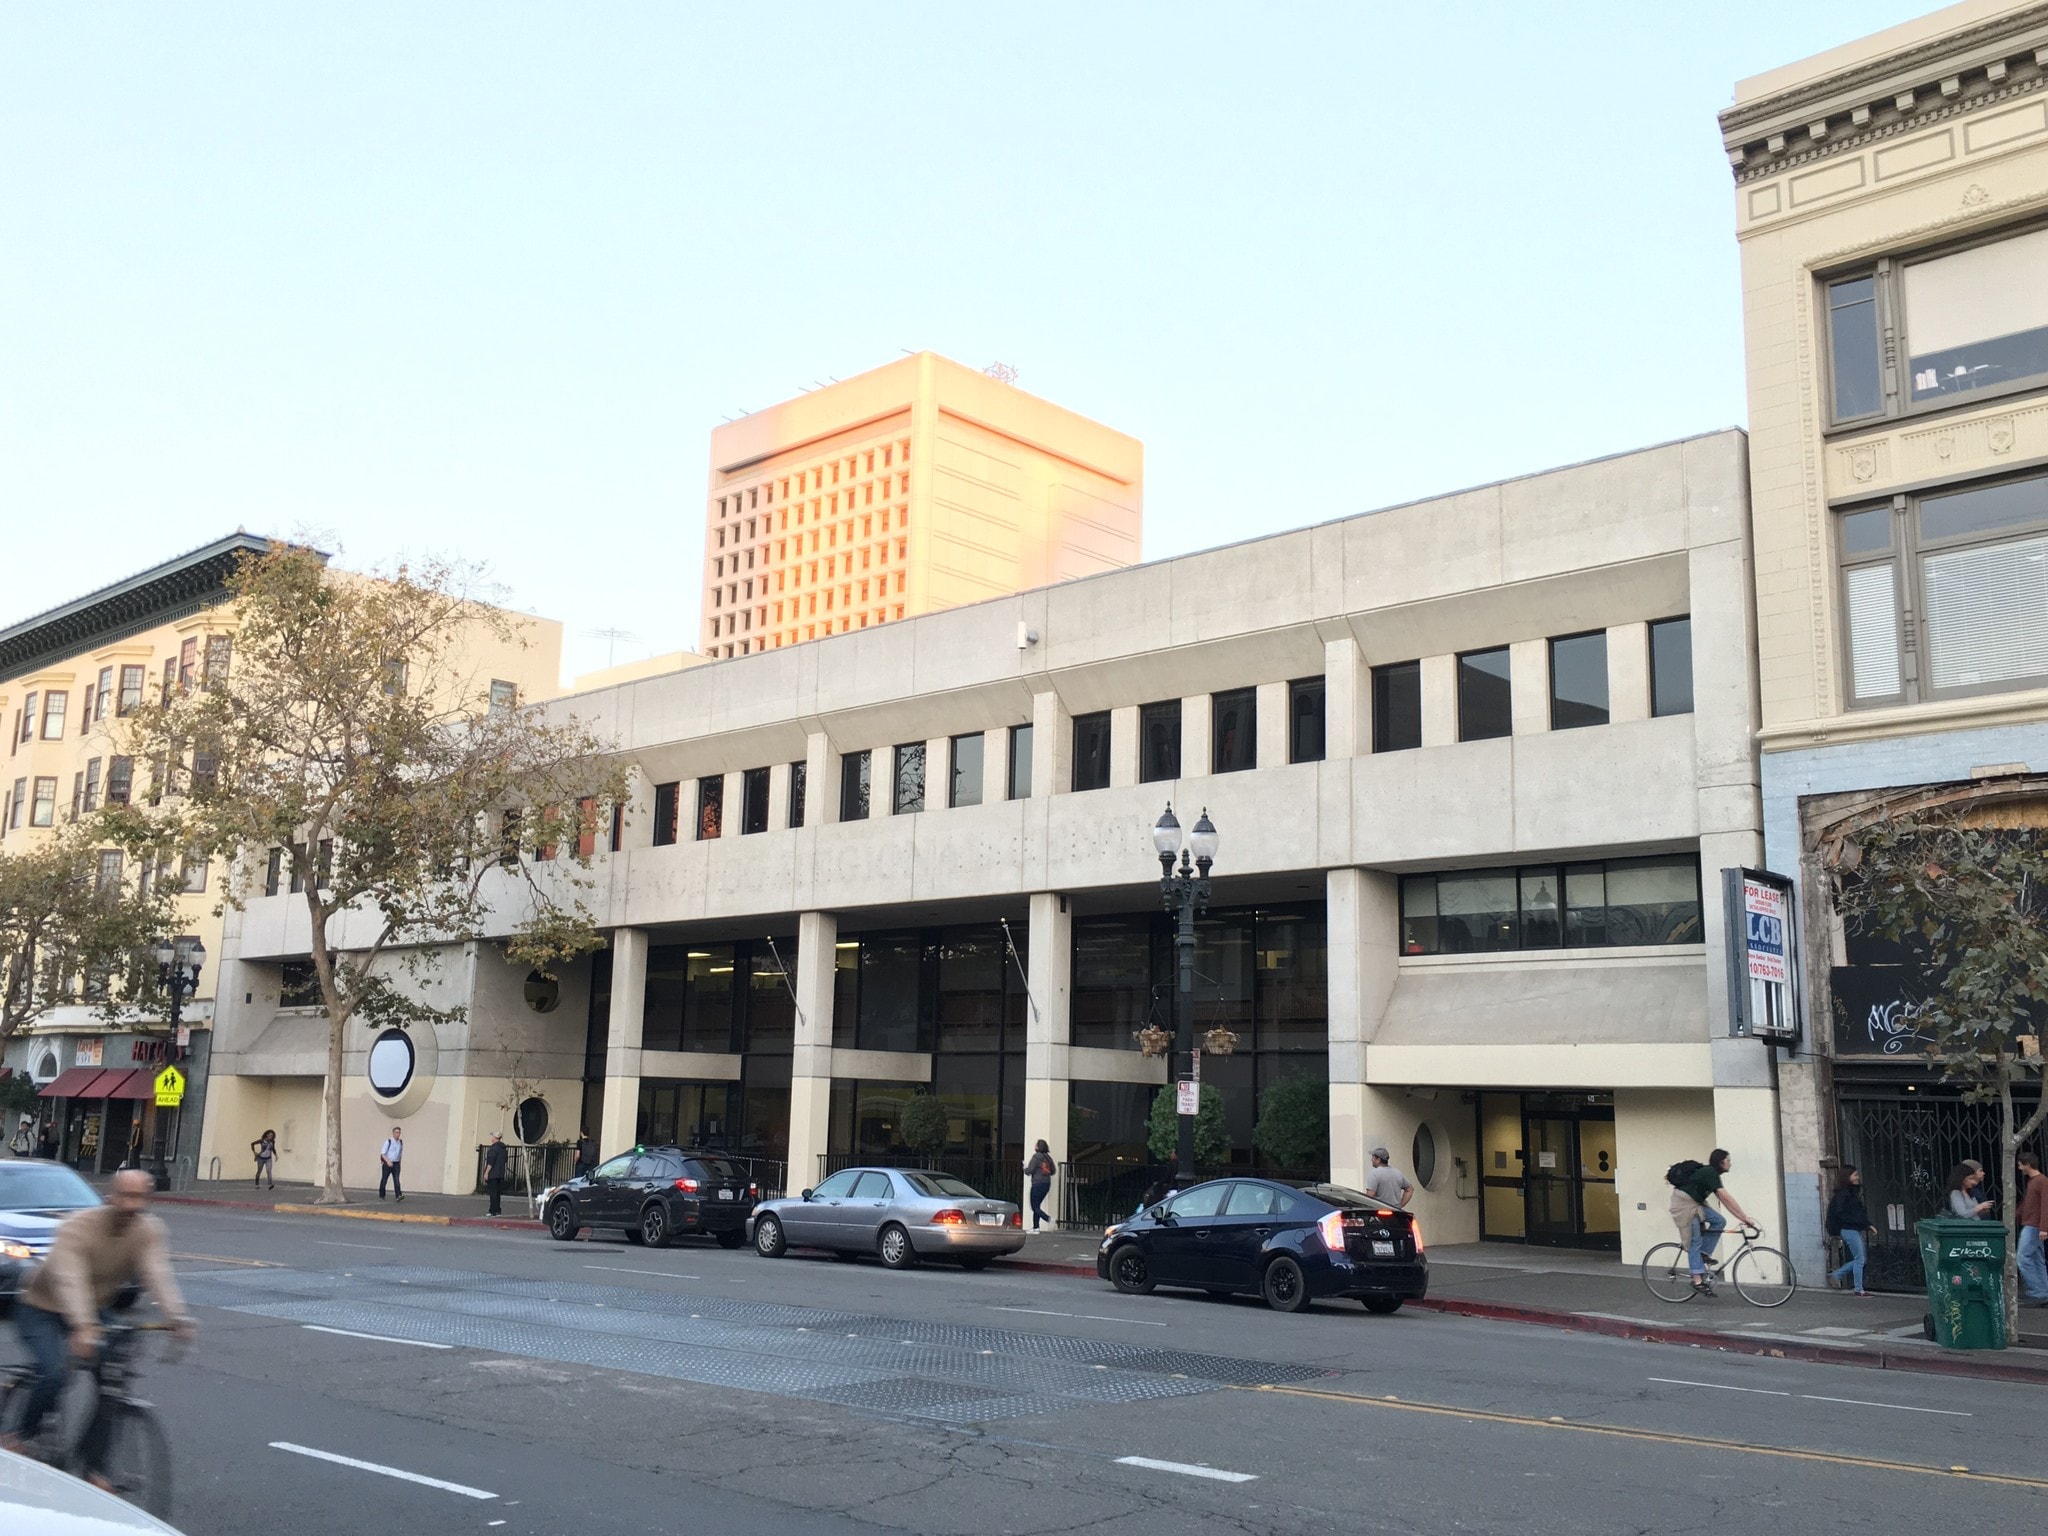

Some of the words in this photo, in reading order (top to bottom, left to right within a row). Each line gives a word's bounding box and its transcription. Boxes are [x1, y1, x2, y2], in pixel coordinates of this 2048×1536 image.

[1744, 886, 1759, 898] FOR
[1760, 889, 1779, 903] LEASE
[1746, 912, 1781, 945] LCB
[1748, 942, 1782, 955] SSOCIATES
